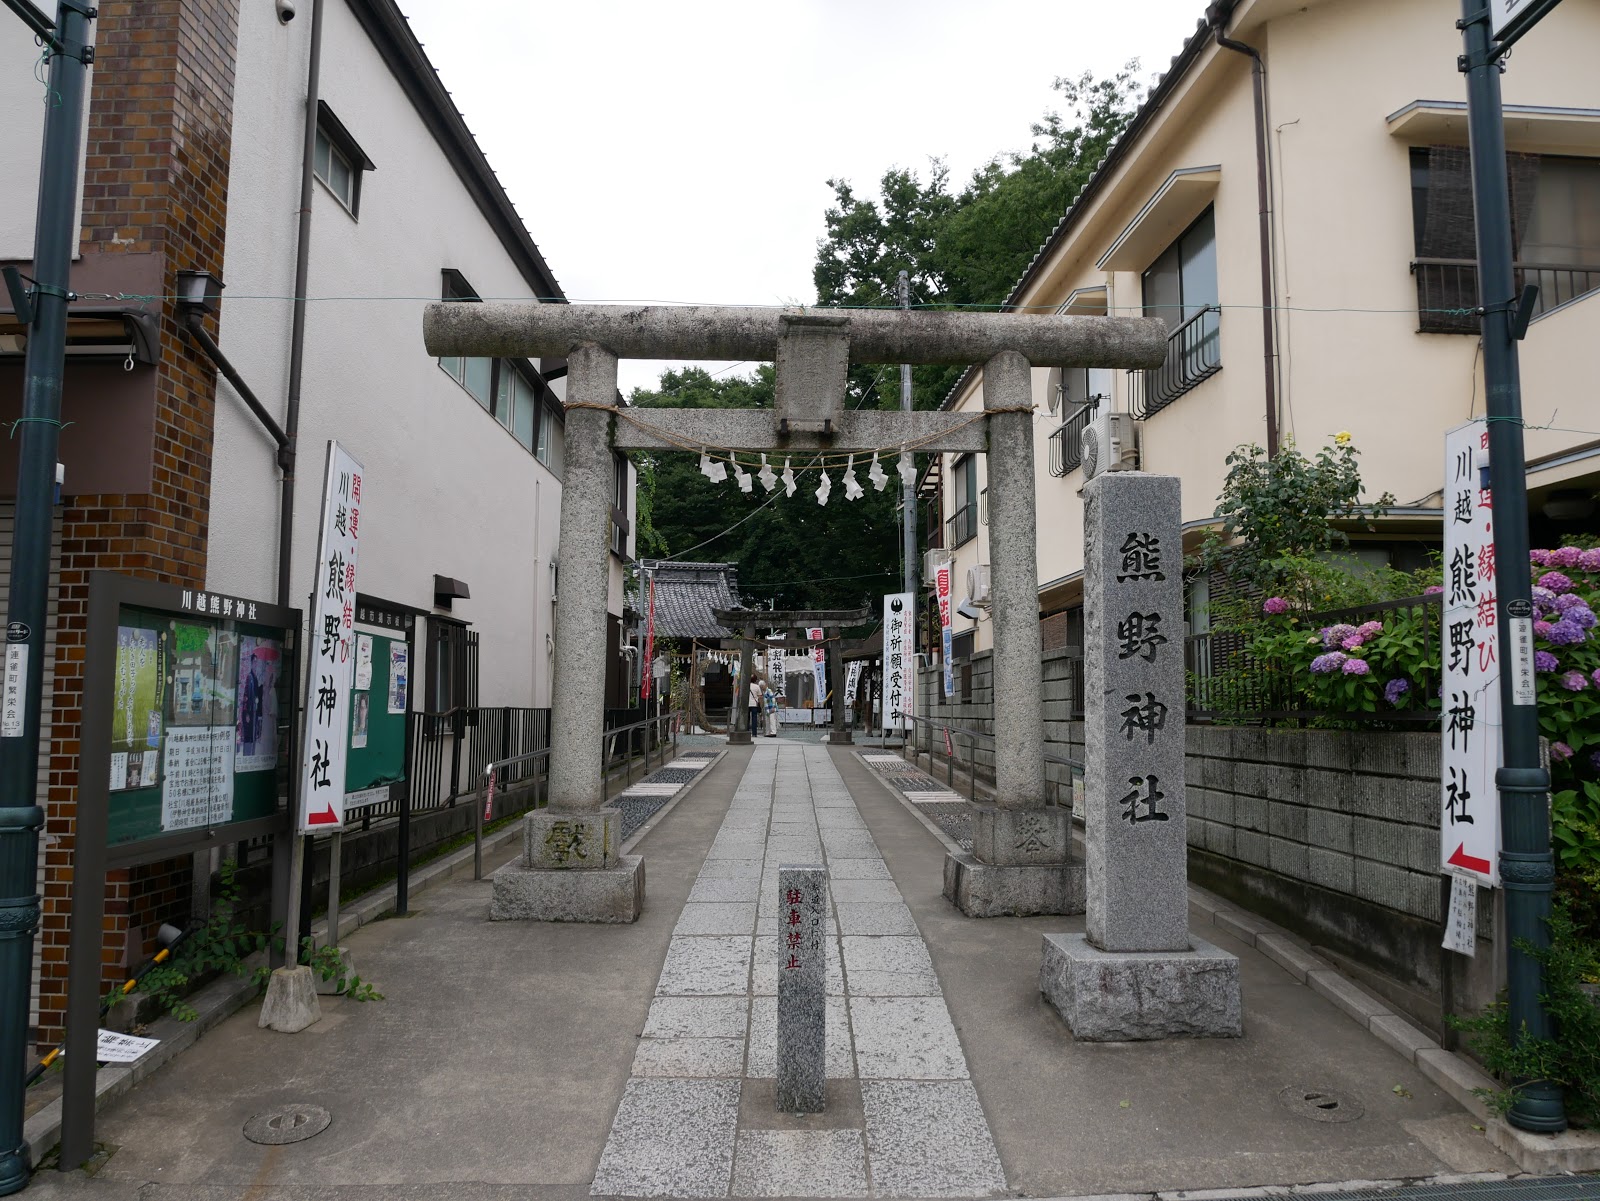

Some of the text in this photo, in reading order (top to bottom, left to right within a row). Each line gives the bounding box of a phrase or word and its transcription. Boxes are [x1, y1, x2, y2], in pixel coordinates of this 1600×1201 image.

[181, 590, 257, 620] 川越熊野神社
[341, 473, 362, 664] 開運・縁結び
[7, 650, 19, 719] 連雀町繁栄会
[309, 471, 350, 792] 川越熊野神社
[890, 618, 902, 725] 御祈願受付中
[1116, 532, 1169, 825] 熊野神社
[1445, 446, 1477, 826] 川越熊野神社
[1519, 624, 1530, 688] 連雀町繁栄会
[785, 888, 803, 970] 駐車禁止
